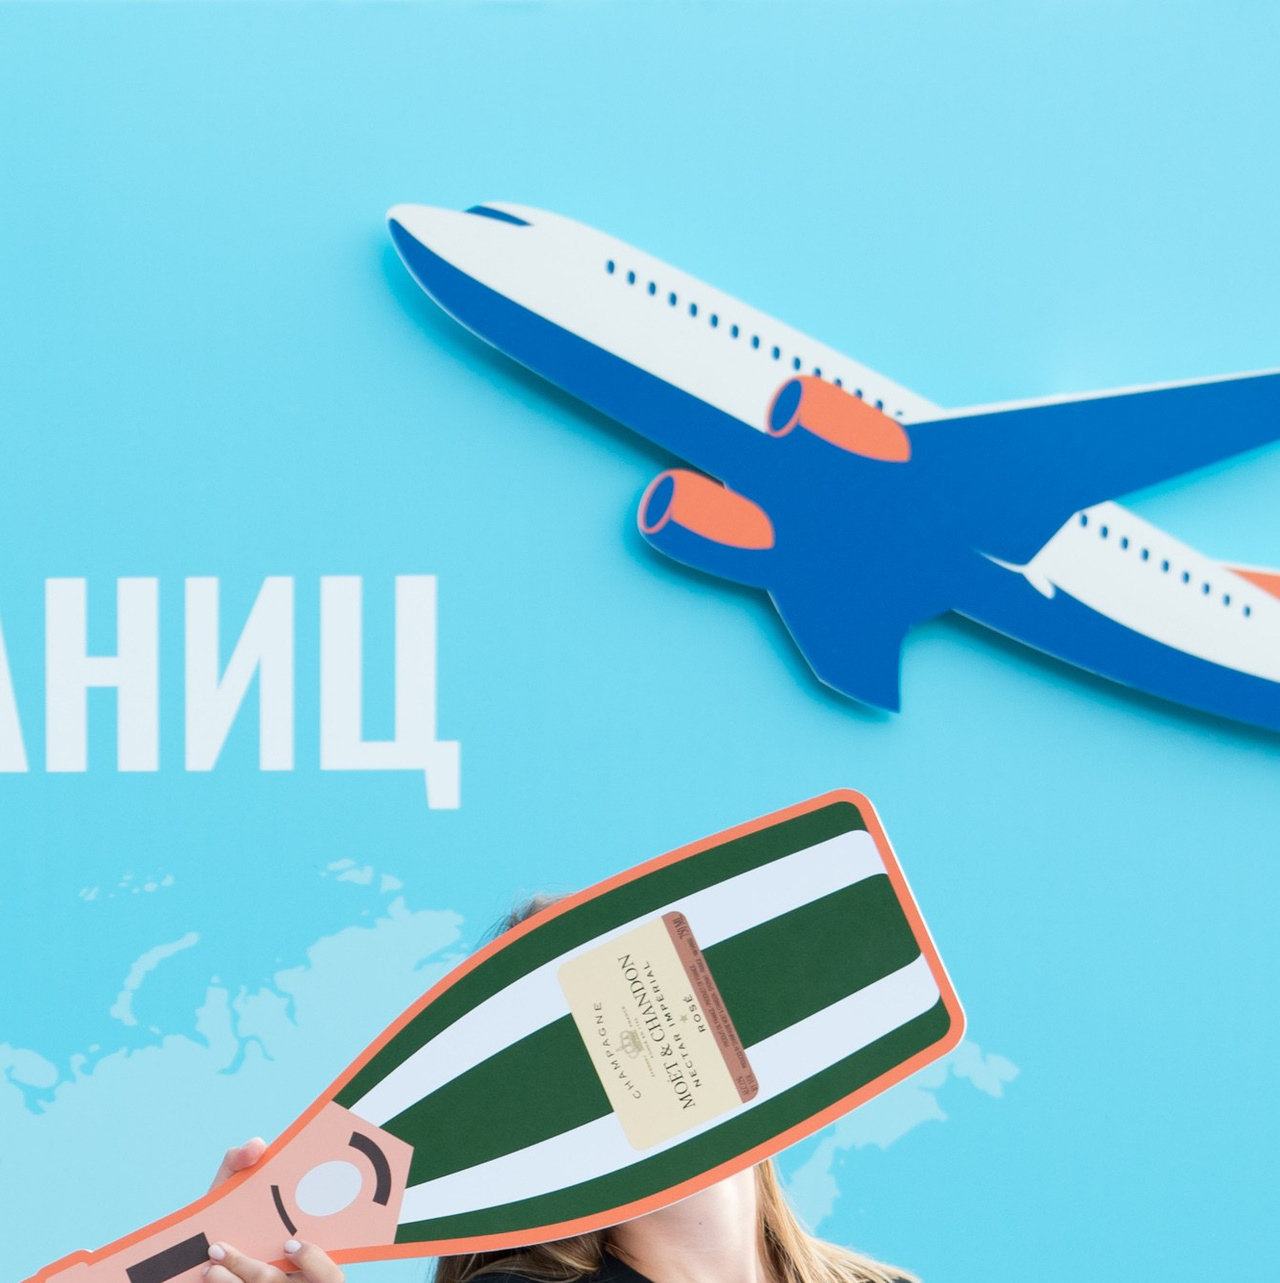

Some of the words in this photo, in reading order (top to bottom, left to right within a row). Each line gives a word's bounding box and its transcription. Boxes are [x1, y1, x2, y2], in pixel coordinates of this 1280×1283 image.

[617, 953, 666, 1043] CHANDON
[681, 992, 707, 1034] ROSÉ
[593, 1001, 642, 1100] CHAMPAGNE
[656, 1041, 674, 1059] &
[671, 1031, 702, 1088] NECTAR
